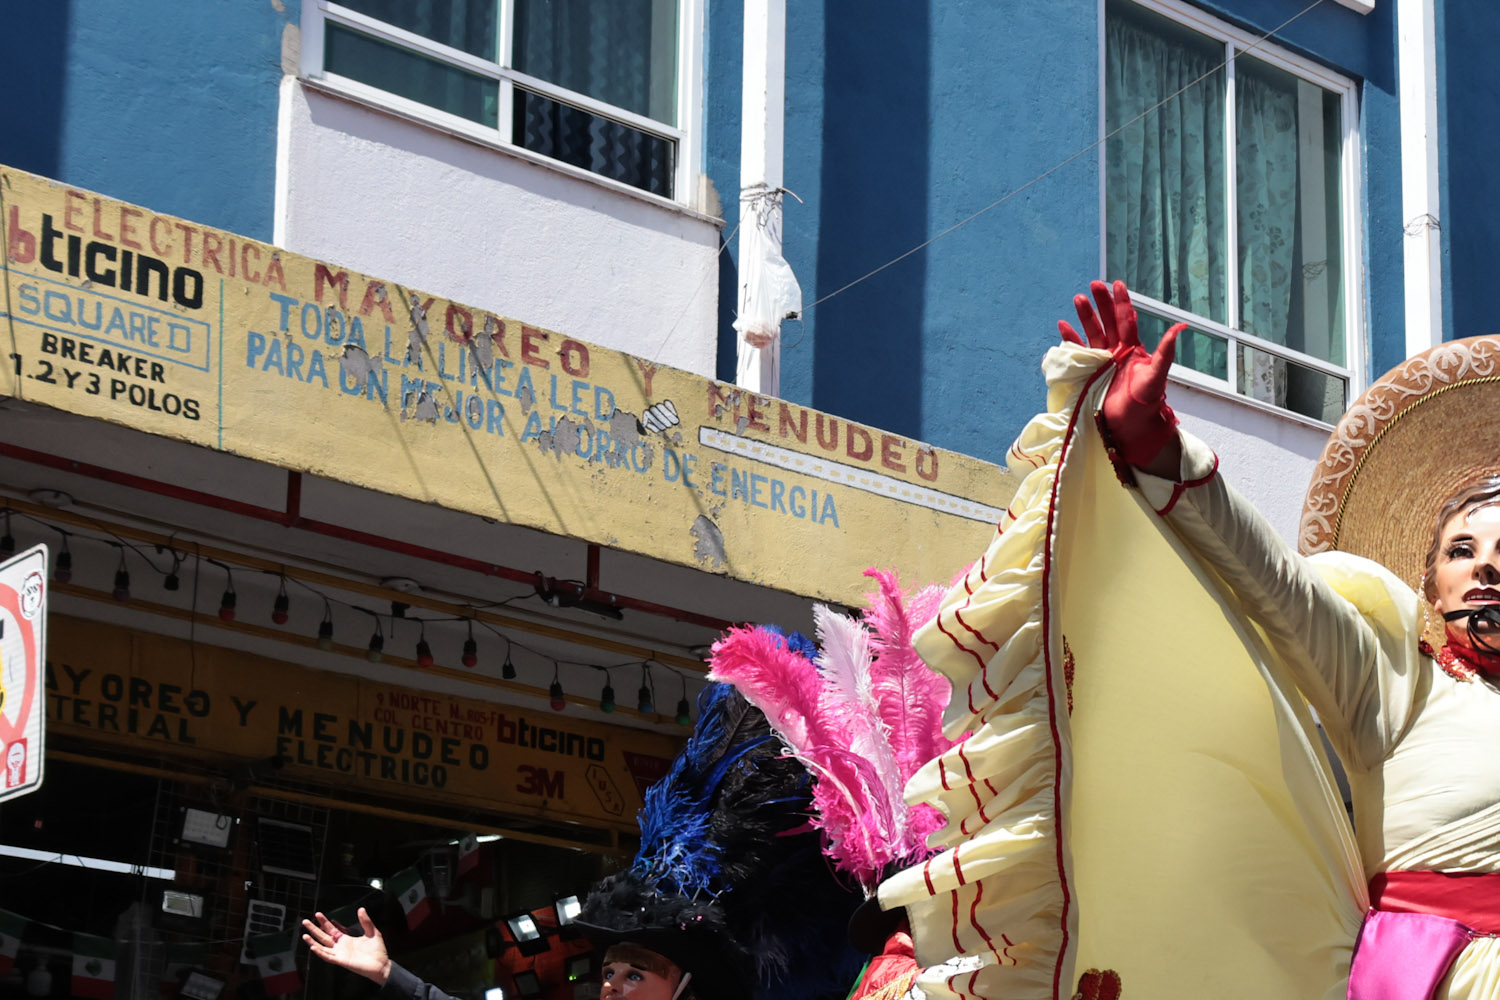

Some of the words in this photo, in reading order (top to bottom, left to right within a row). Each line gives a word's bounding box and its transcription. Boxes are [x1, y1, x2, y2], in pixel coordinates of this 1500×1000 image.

[8, 204, 204, 310] bticino
[41, 332, 165, 384] BREAKER
[64, 190, 288, 292] ELECTRICA
[636, 358, 658, 398] Y
[707, 381, 939, 483] MENUDEO
[269, 291, 367, 350] TODA
[438, 341, 537, 405] LINEA
[550, 373, 617, 422] LED
[63, 367, 81, 389] Y
[85, 372, 101, 396] 3
[110, 378, 200, 421] POLOS
[246, 330, 329, 389] PARA
[663, 447, 698, 489] DE
[711, 461, 840, 529] ENERGIA
[46, 660, 211, 718] AYOREO
[230, 695, 258, 727] Y
[278, 705, 489, 771] MENUDEO
[46, 693, 197, 744] TERIAL
[276, 735, 447, 789] ELECTRICO
[389, 691, 441, 716] NORTE
[412, 714, 484, 741] CENTRO
[496, 713, 605, 762] bticino
[516, 764, 565, 800] 3M
